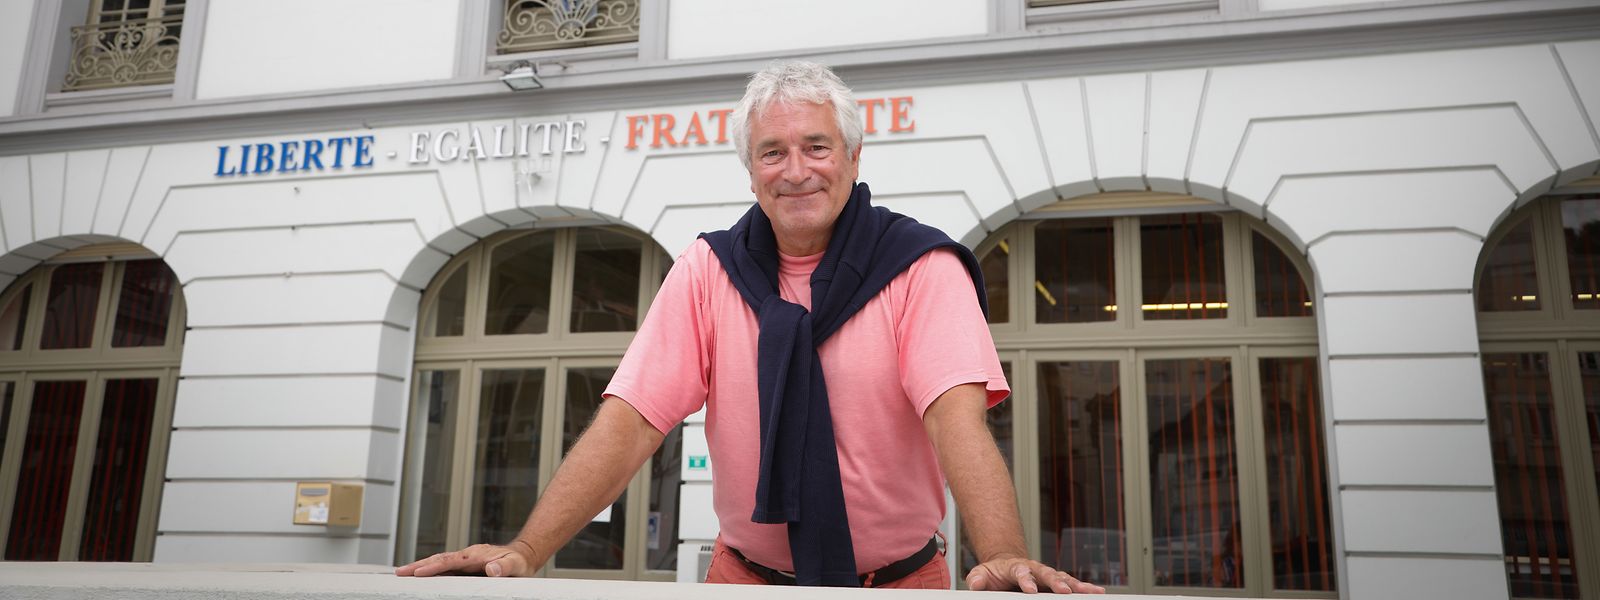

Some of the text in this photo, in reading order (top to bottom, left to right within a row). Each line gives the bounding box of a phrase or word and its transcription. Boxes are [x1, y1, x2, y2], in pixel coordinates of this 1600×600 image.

[215, 135, 375, 177] LIBERTE
[408, 119, 587, 164] EGALITE
[625, 96, 915, 150] FRATTE
